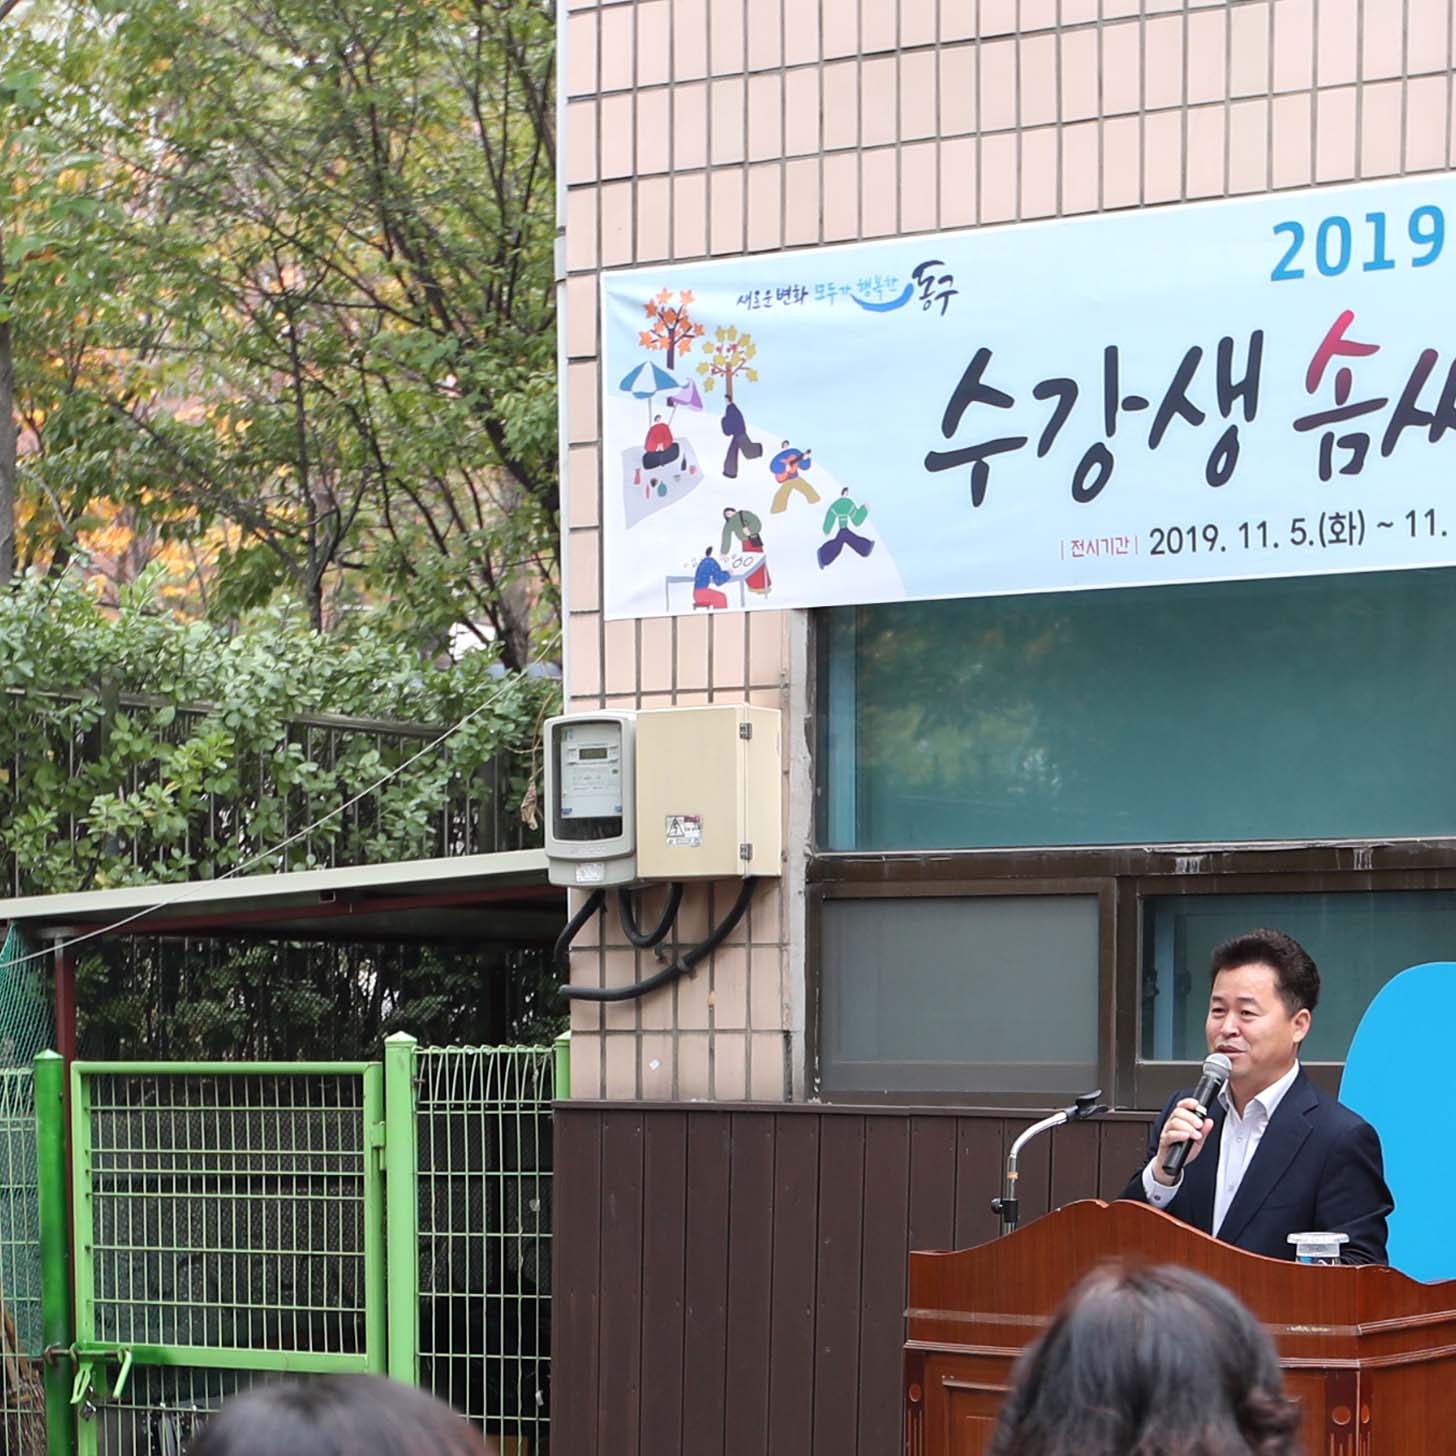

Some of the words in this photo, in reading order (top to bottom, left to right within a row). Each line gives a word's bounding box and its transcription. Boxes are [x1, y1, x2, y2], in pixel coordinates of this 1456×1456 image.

[776, 284, 808, 305] 변화
[924, 330, 1263, 507] 수강생
[1150, 524, 1225, 555] 2019.
